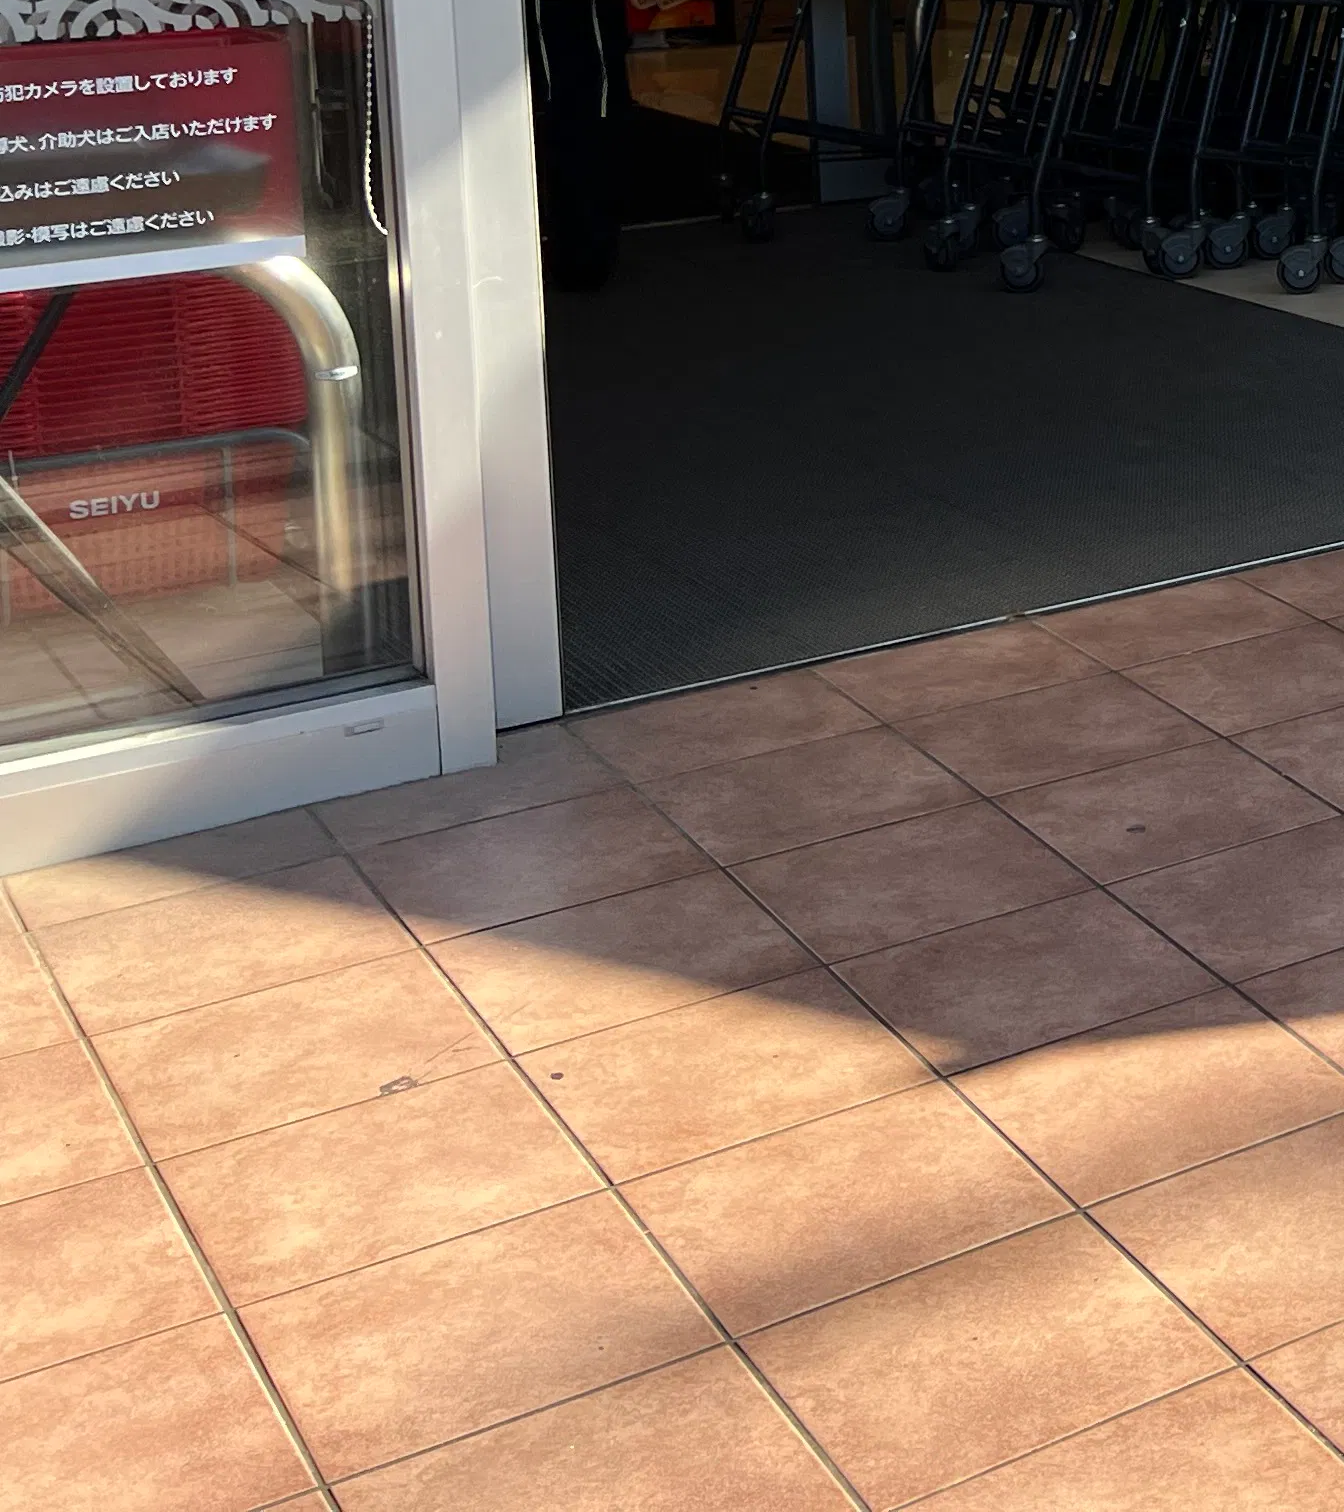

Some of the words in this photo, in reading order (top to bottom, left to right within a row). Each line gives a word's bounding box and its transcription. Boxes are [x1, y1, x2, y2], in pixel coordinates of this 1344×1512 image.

[0, 113, 277, 155] 犬、介助犬はご入店いただけます
[69, 490, 161, 519] SEIYU
